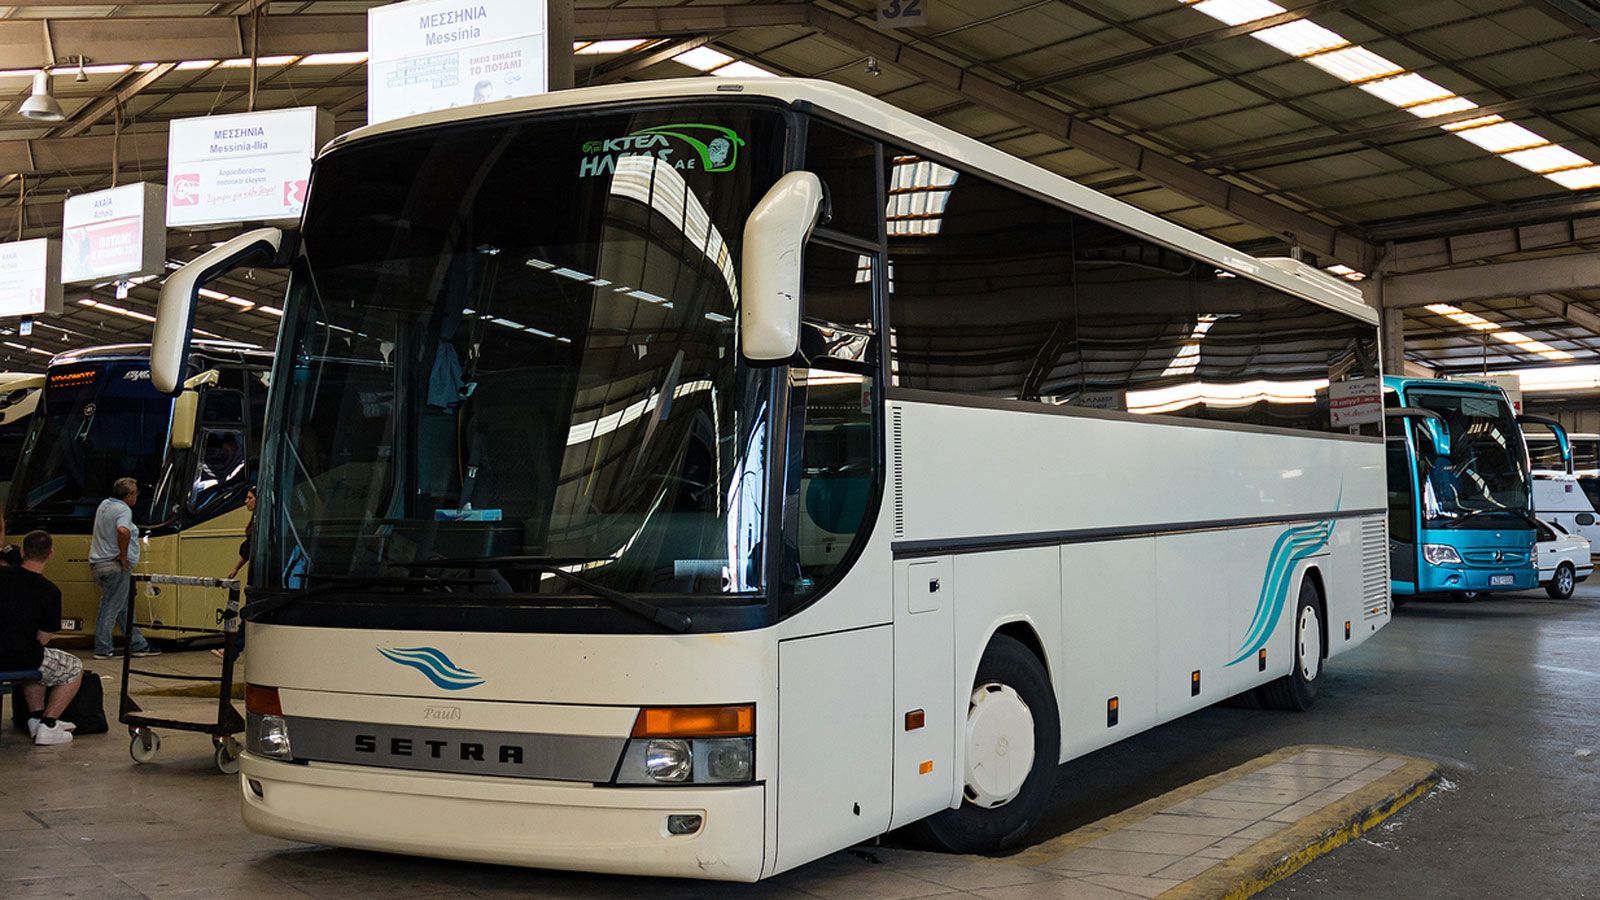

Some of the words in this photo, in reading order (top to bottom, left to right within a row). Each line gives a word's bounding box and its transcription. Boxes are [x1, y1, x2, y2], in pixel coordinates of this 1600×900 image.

[419, 6, 487, 30] ΜΕΣΣΗΝΙΑ
[882, 0, 922, 19] 32
[425, 26, 481, 46] Messinia
[214, 127, 265, 140] ΜΕΣΣΗΝΙΑ
[355, 734, 524, 764] SETRA
